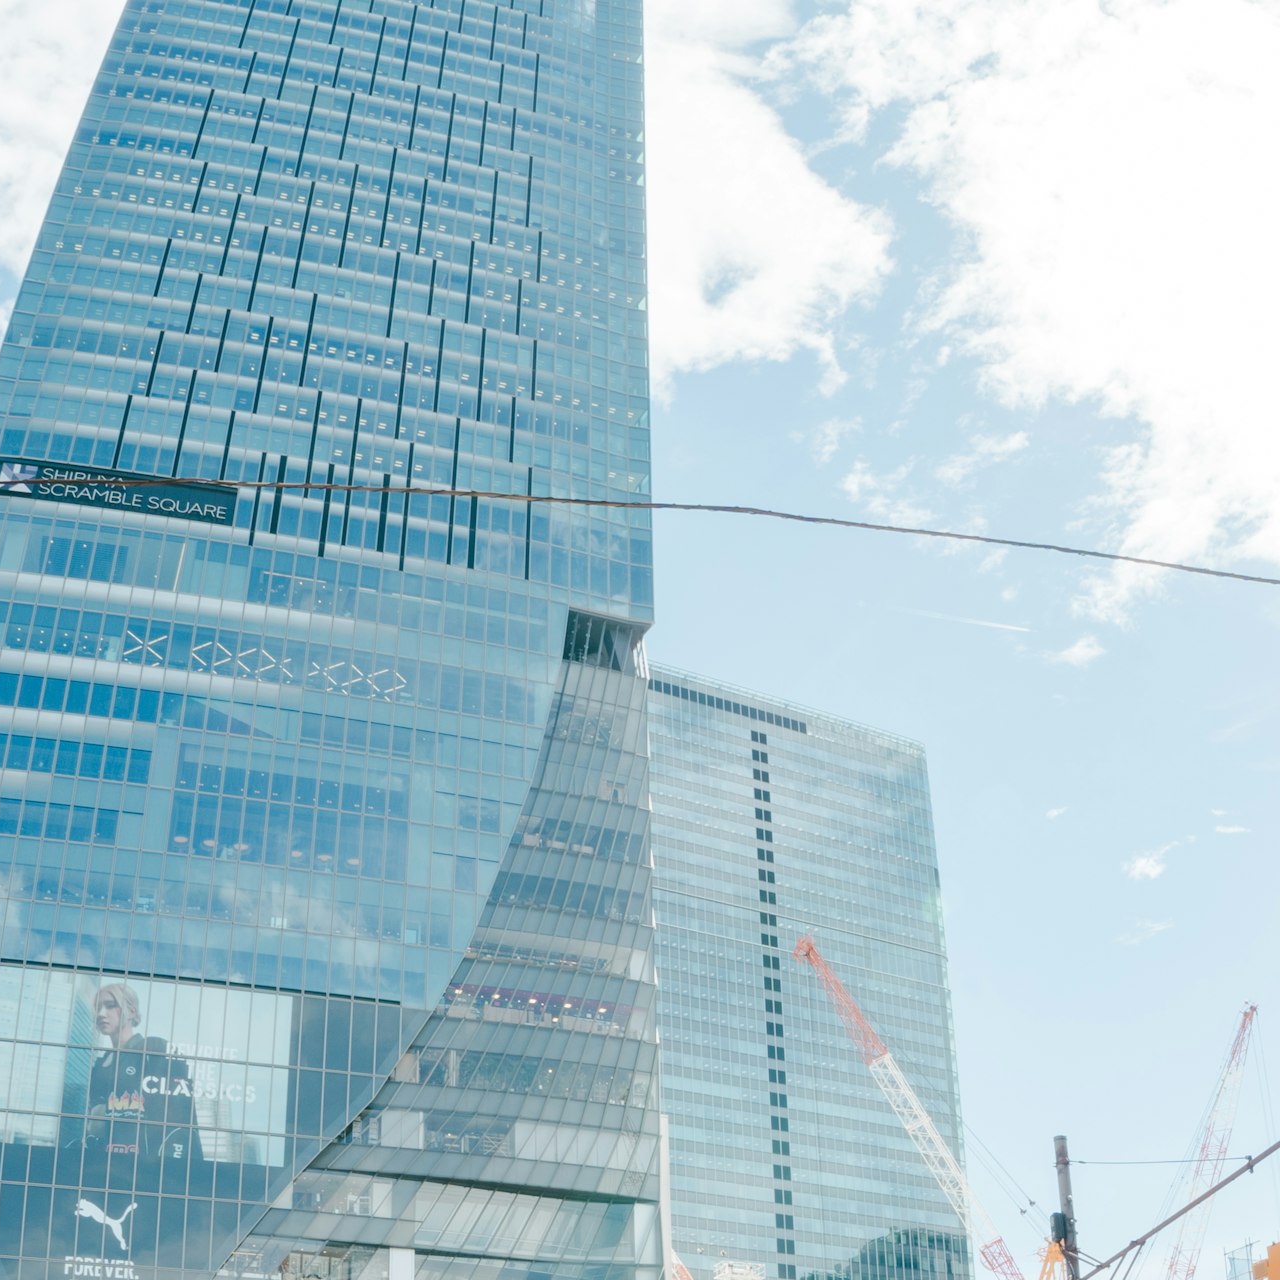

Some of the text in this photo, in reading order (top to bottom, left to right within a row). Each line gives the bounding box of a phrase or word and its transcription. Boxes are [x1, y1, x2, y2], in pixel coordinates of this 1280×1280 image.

[38, 482, 227, 519] SCRAMBLE SQUARE
[166, 1042, 239, 1061] REWRITE
[187, 1062, 215, 1081] THE
[141, 1075, 257, 1103] CLASSICS
[64, 1256, 139, 1280] FOREVER.
